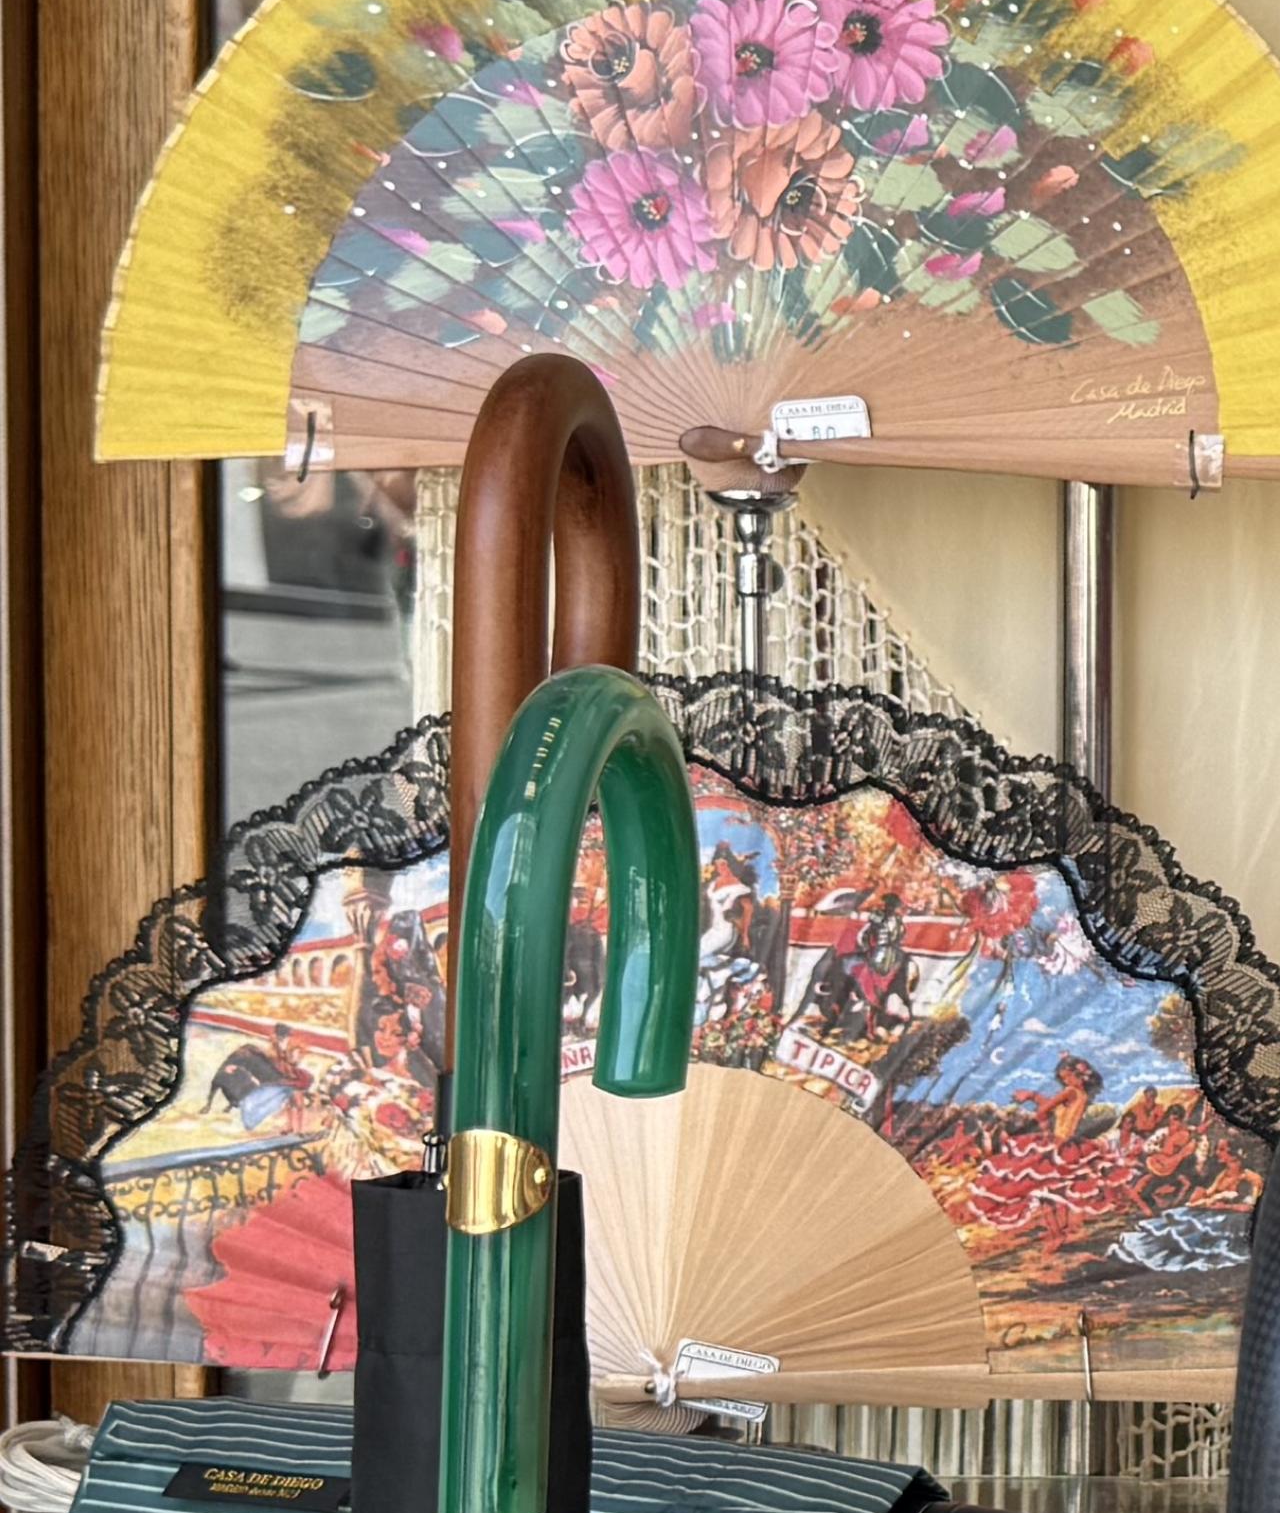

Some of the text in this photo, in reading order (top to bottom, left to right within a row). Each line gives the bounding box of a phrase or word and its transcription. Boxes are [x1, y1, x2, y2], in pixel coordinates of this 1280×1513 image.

[1070, 378, 1120, 404] Casa
[1126, 373, 1151, 395] de
[1106, 396, 1186, 424] Madrid
[203, 1468, 325, 1491] CASA DE DIEGO
